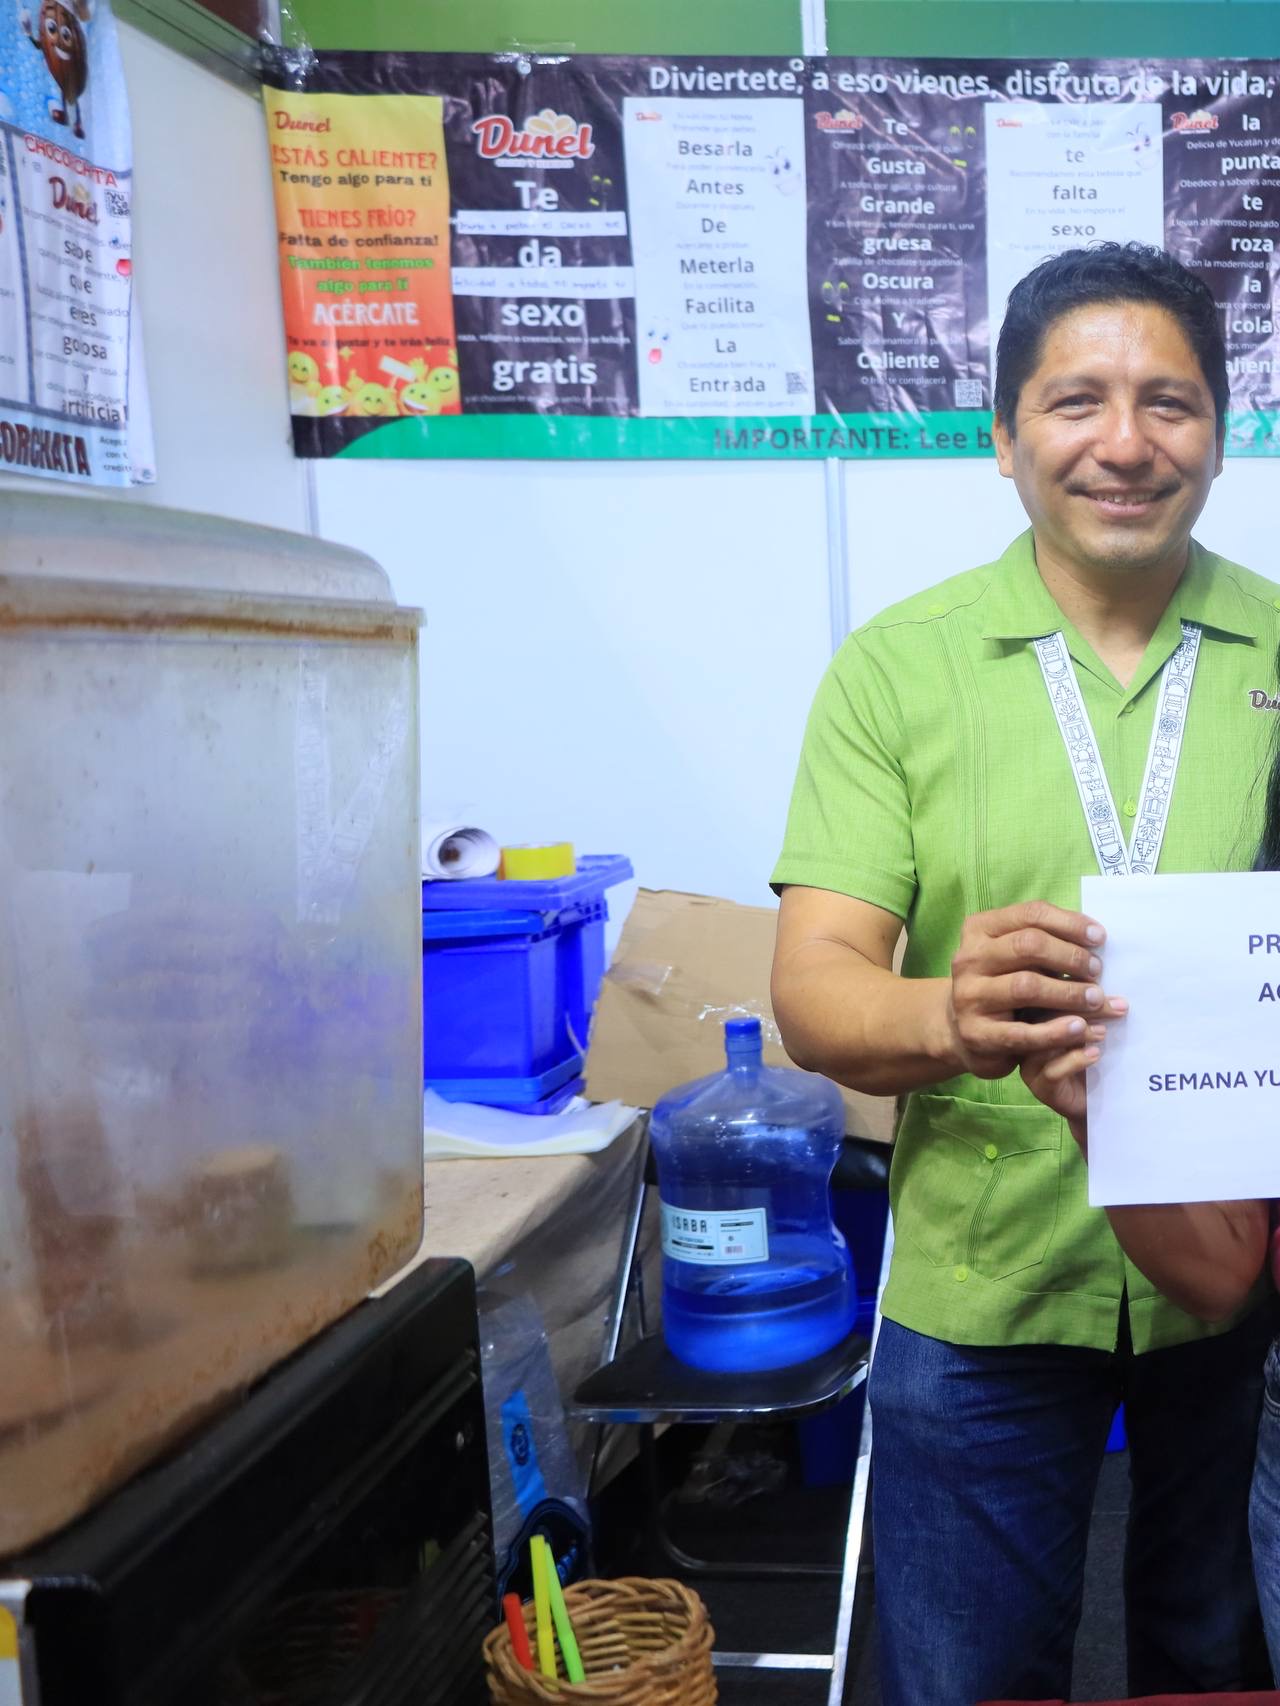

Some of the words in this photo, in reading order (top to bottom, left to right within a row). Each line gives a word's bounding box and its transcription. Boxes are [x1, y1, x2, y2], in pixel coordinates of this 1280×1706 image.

[649, 66, 803, 94] Diviertete,
[812, 72, 829, 90] a
[838, 72, 888, 93] eso
[898, 70, 998, 97] vienes,
[1006, 68, 1120, 96] disfruta
[1129, 70, 1164, 96] de
[1173, 71, 1197, 96] la
[1206, 71, 1274, 98] vida,
[274, 111, 332, 133] Dunel
[883, 118, 909, 136] Te
[1242, 114, 1261, 131] la
[473, 115, 595, 159] Dunel
[678, 140, 753, 157] Besarla
[1066, 149, 1084, 163] te
[336, 149, 438, 170] CALIENTE?
[866, 157, 927, 176] Gusta
[280, 170, 332, 188] Tengo
[338, 172, 370, 188] algo
[375, 173, 414, 187] para
[685, 178, 745, 196] Antes
[514, 181, 559, 210] Te
[1053, 184, 1099, 200] falta
[860, 196, 935, 215] Grande
[1242, 195, 1264, 211] te
[298, 208, 362, 228] TIENES
[367, 205, 416, 228] FRÍO?
[701, 217, 728, 234] De
[1051, 224, 1097, 237] sexo
[328, 234, 349, 247] de
[863, 237, 932, 256] gruesa
[1231, 237, 1274, 252] roza
[518, 238, 562, 267] da
[680, 257, 755, 275] Meterla
[862, 273, 934, 290] Oscura
[1244, 275, 1262, 293] la
[312, 299, 420, 327] ACÉRCATE
[501, 302, 585, 327] sexo
[685, 297, 755, 314] Facilita
[892, 312, 906, 329] Y
[1232, 316, 1273, 334] cola
[715, 338, 737, 354] La
[493, 355, 598, 392] gratis
[689, 376, 766, 393] Entrada
[713, 428, 909, 450] IMPORTANTE:
[919, 429, 969, 450] Lee
[0, 420, 92, 477] ORCHATA
[1148, 1071, 1248, 1092] SEMANA
